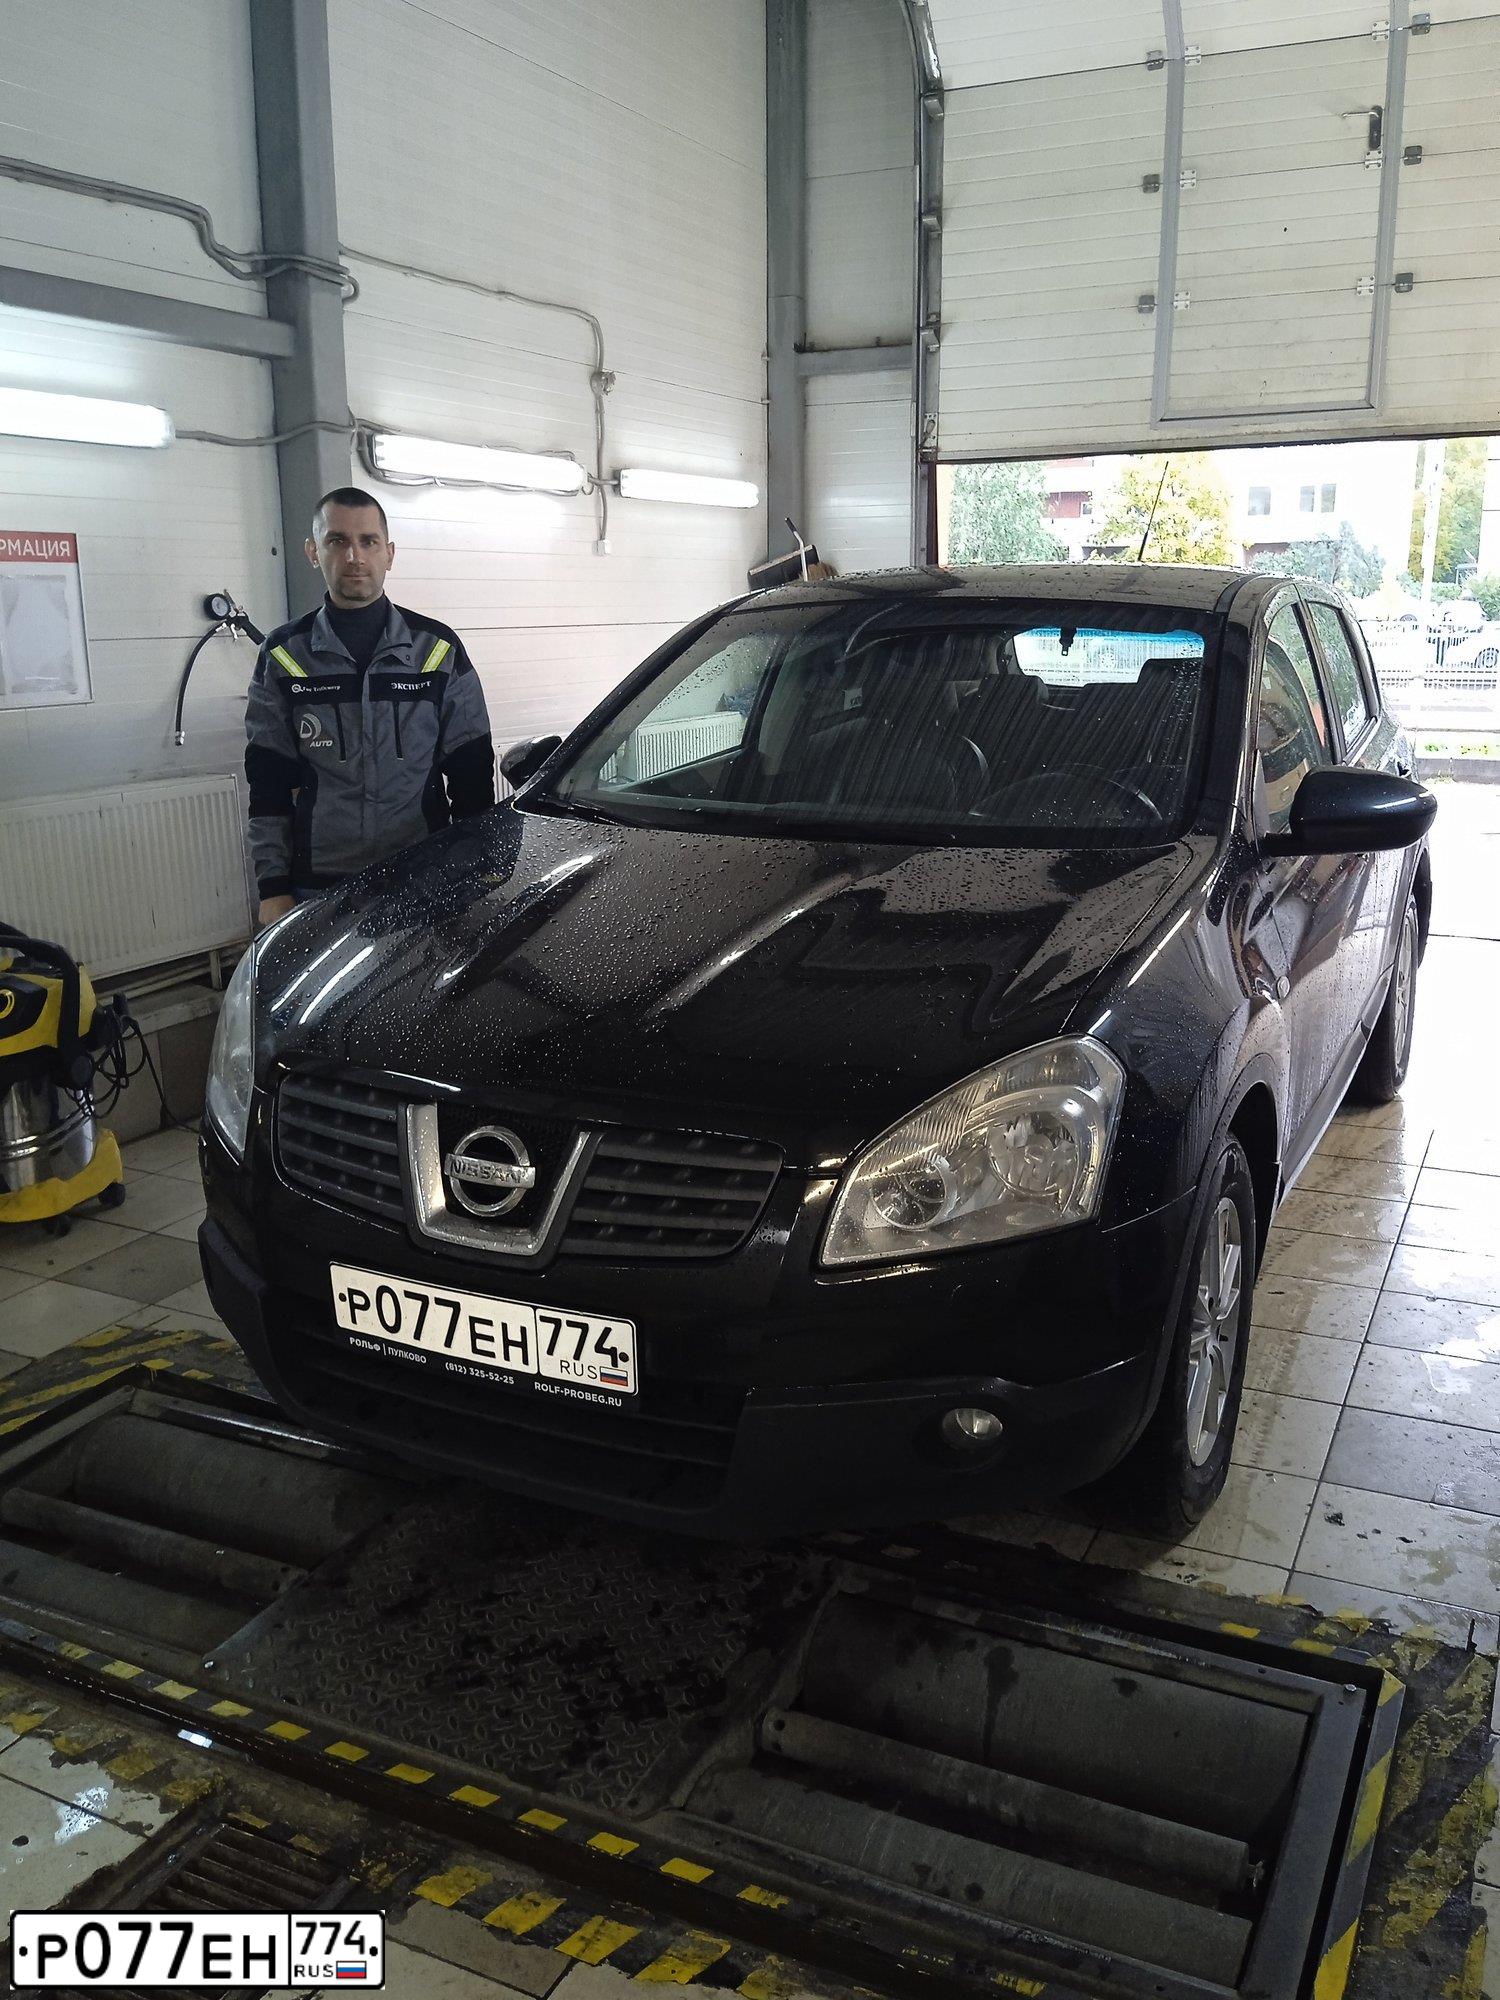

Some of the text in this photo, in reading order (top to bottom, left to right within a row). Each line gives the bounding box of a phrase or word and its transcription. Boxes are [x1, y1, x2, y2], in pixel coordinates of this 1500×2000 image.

[310, 740, 333, 748] AUTO
[451, 1160, 525, 1183] NISSAN
[539, 1315, 619, 1368] 774
[387, 1346, 427, 1364] ПУЛКОВО
[445, 1361, 515, 1385] (812) 325-52-25
[560, 1359, 598, 1380] RUS
[534, 1381, 622, 1407] ROLF-PROBEG.RU
